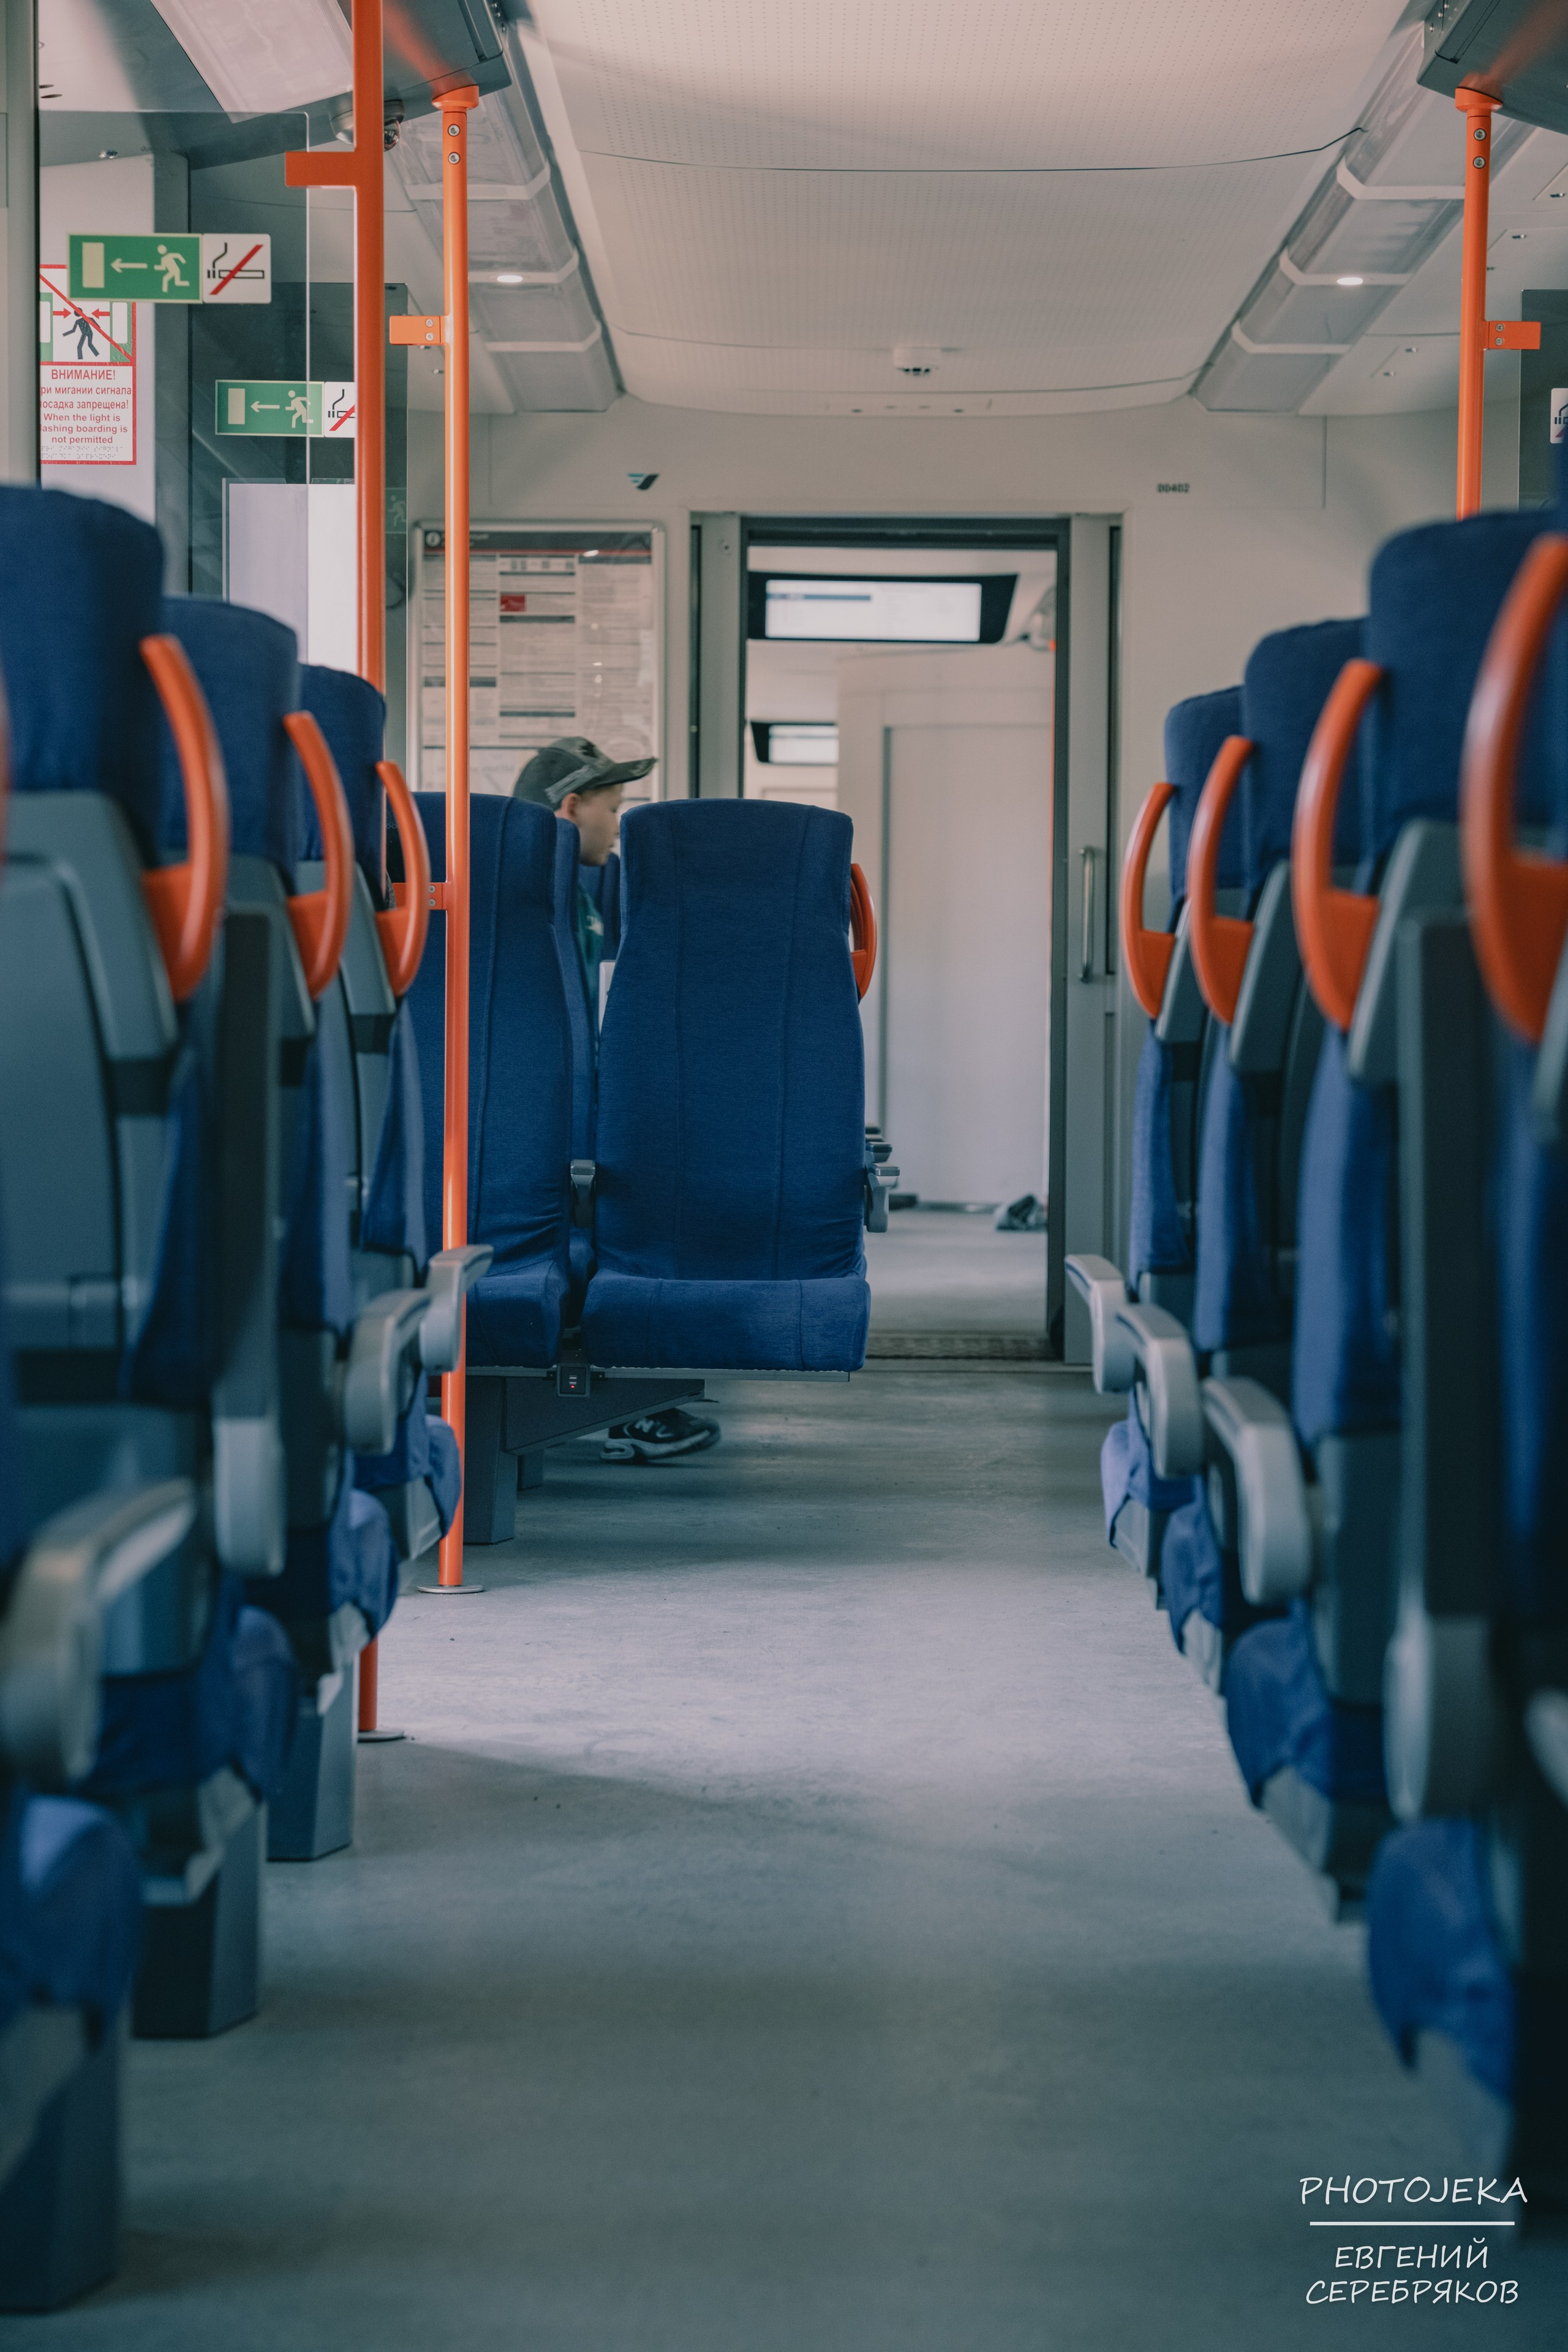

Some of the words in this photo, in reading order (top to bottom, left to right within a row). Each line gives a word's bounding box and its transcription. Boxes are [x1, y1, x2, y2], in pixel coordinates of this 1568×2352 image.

[51, 369, 116, 380] ВНИМАНИЕ!
[40, 386, 52, 396] ри
[77, 399, 129, 411] запрещена!
[43, 413, 70, 421] When
[90, 414, 110, 423] light
[40, 424, 74, 434] lashing
[76, 424, 117, 435] boarding
[69, 436, 113, 445] permitted
